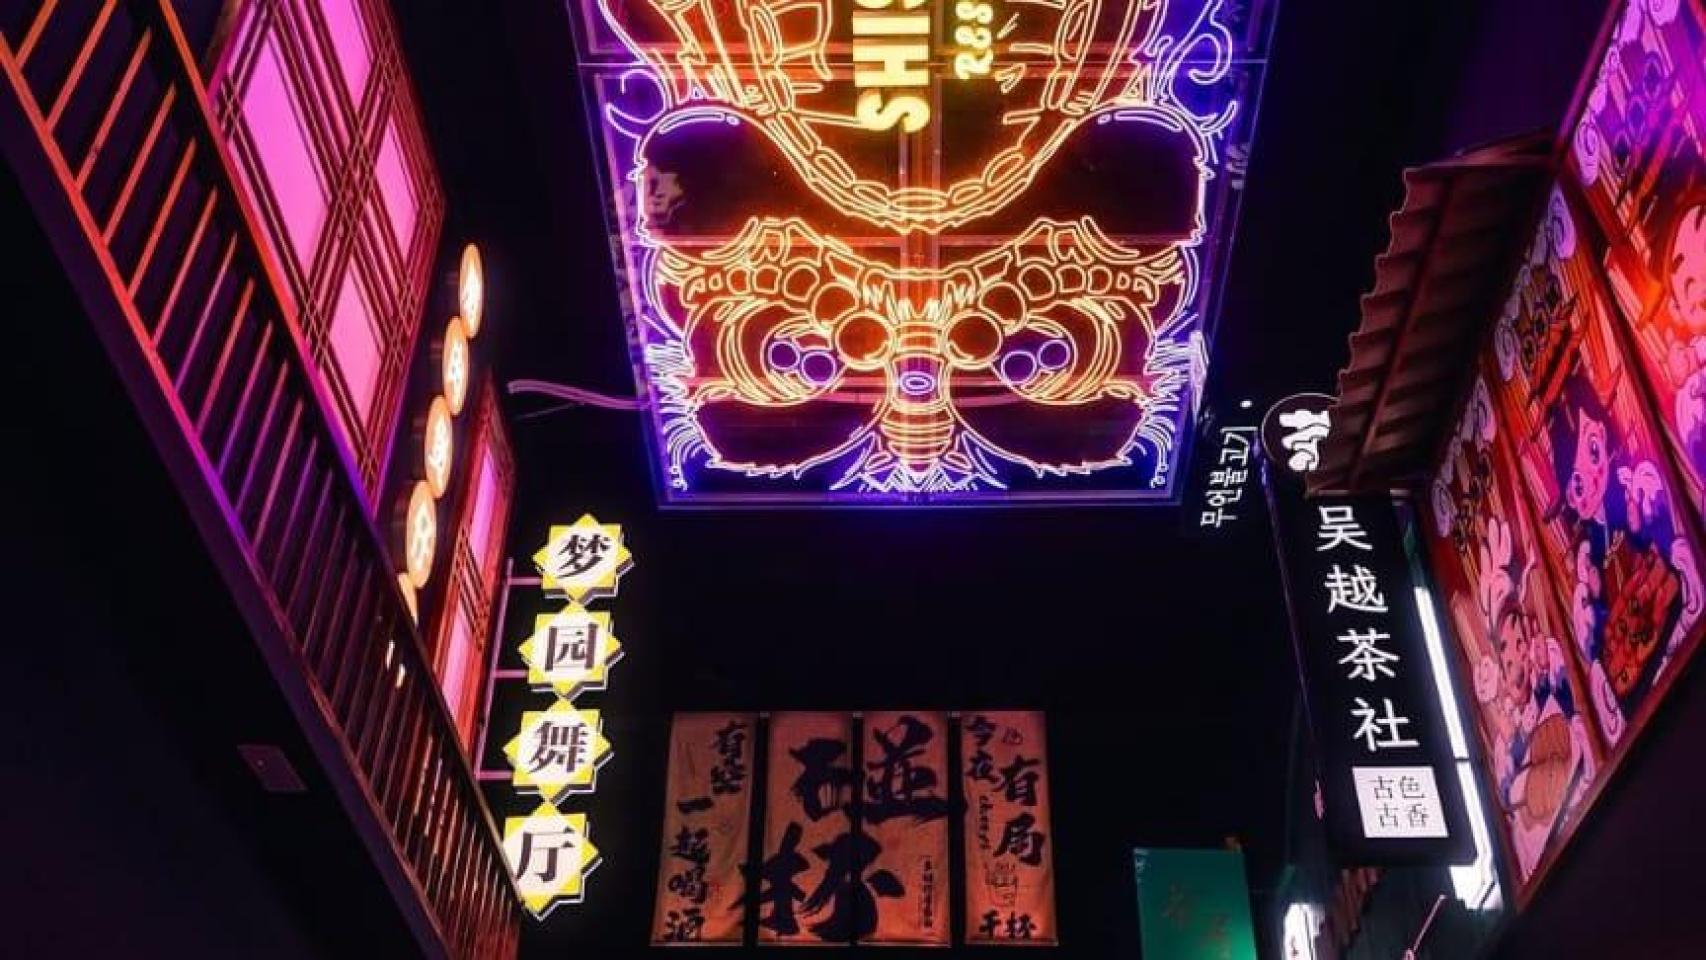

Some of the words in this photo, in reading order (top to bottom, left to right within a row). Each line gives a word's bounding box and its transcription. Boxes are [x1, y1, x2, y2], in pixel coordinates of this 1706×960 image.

[853, 0, 930, 133] SHI
[513, 532, 612, 884] 梦园舞厅
[1316, 505, 1419, 751] 吴越茶社
